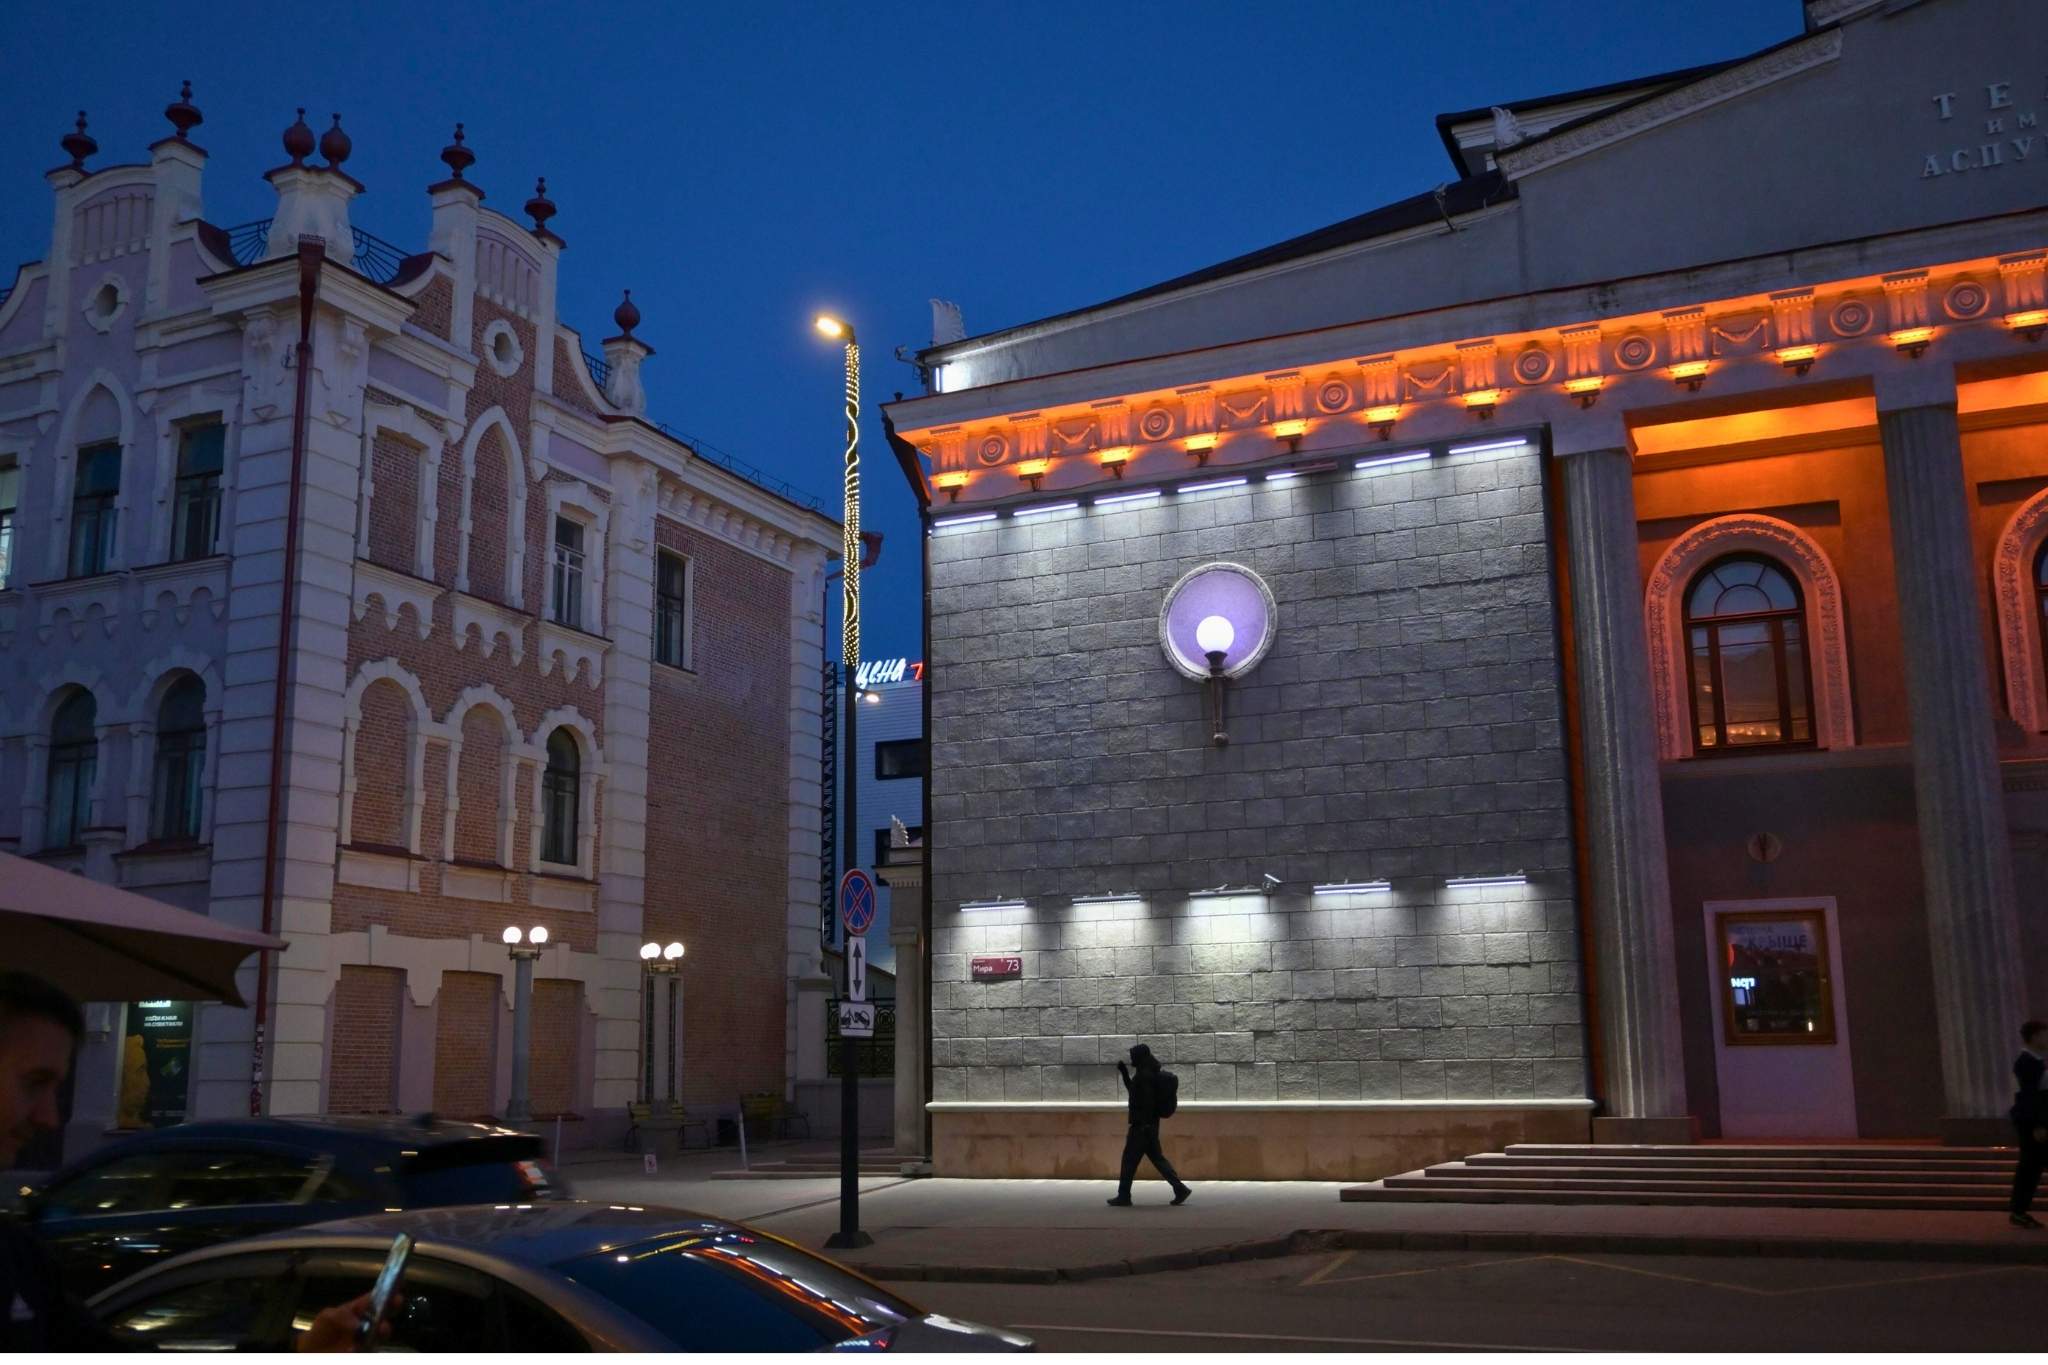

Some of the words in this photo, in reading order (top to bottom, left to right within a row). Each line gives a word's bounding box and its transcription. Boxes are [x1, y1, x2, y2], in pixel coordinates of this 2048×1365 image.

[1931, 75, 2048, 120] ТЕ
[1920, 132, 2048, 178] А.С.ПУ
[973, 965, 993, 974] Мира
[1006, 959, 1019, 971] 73
